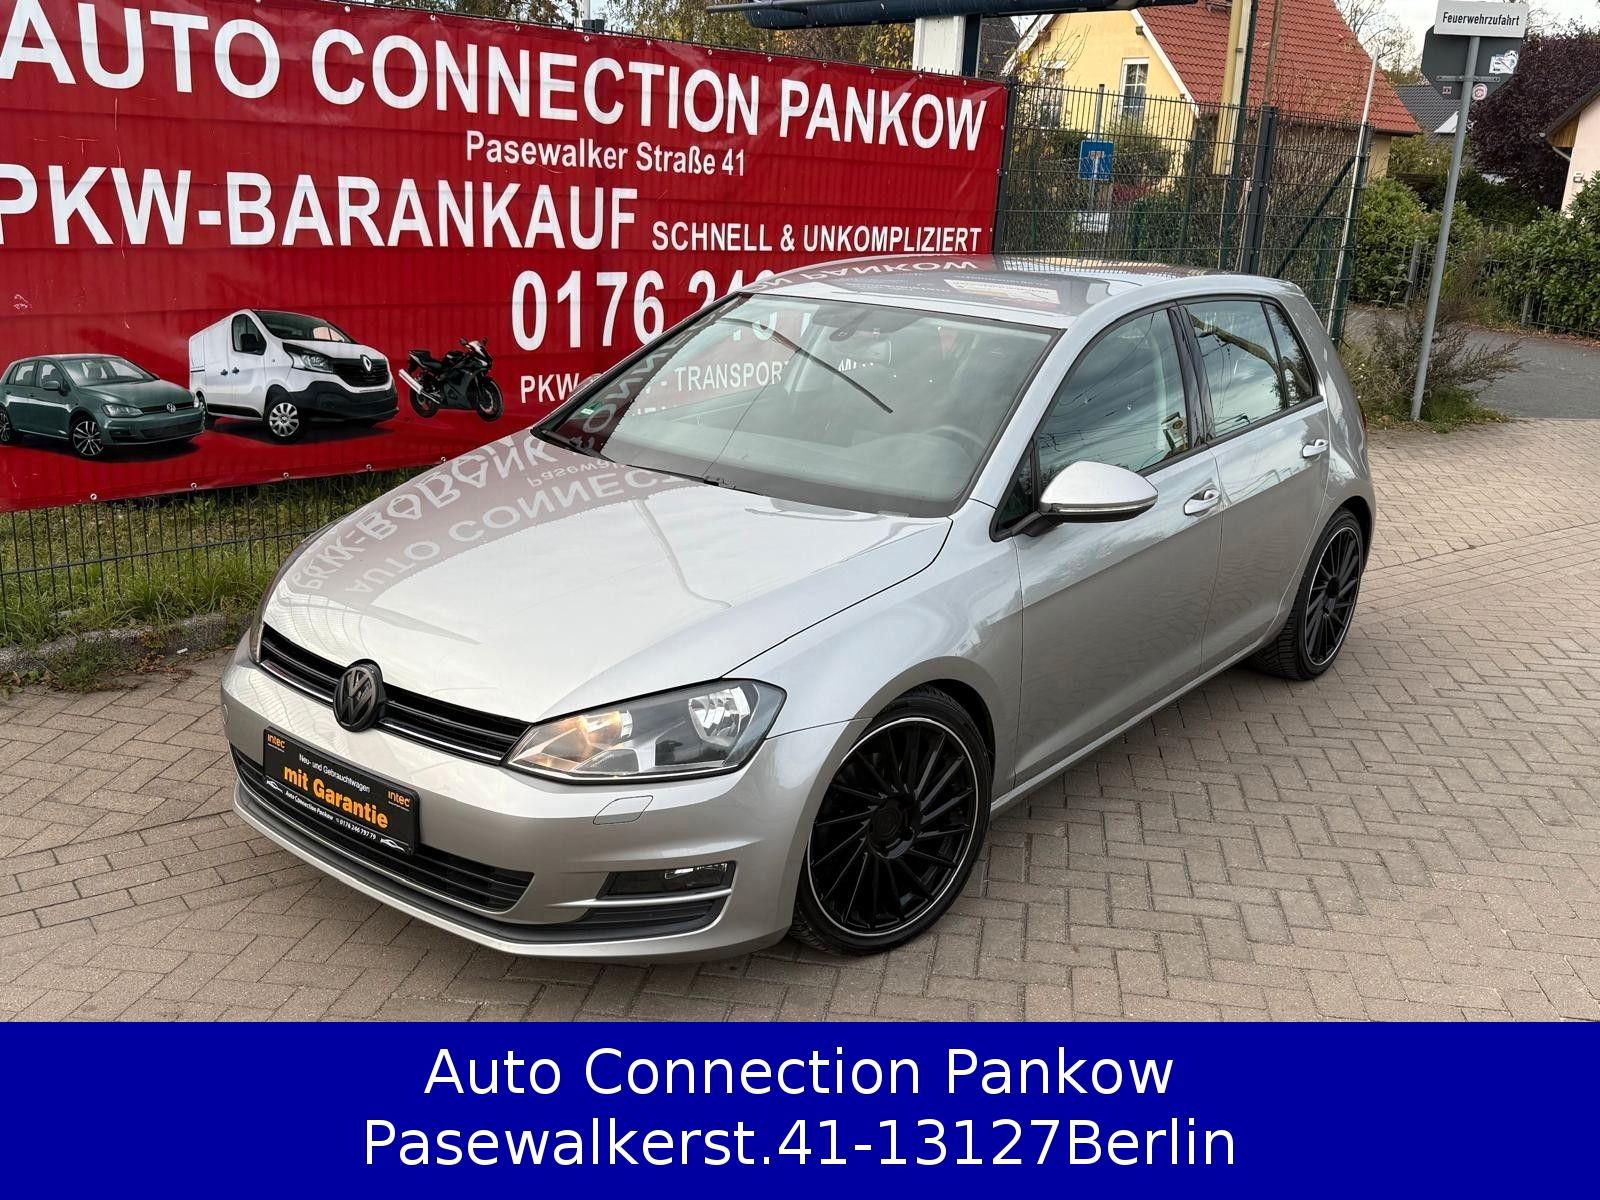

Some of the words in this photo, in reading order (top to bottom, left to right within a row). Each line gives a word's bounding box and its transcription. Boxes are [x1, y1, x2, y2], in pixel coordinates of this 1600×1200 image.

[1442, 11, 1520, 26] Feuerwehrzufahrt
[0, 0, 281, 99] AUTO
[311, 28, 759, 136] CONNECTION
[779, 78, 986, 151] PANKOW
[466, 130, 629, 170] Pasewalker
[636, 141, 716, 175] Straße
[721, 148, 745, 176] 41
[0, 163, 638, 249] PKW-BARANKAUF
[651, 220, 773, 252] SCHNELL
[780, 223, 796, 252] &
[803, 224, 982, 252] UNKOMPLIZIERT
[511, 270, 667, 351] 0176
[520, 373, 579, 404] PKW
[674, 360, 790, 392] TRANSPOR
[298, 753, 312, 765] Neu-
[311, 761, 323, 772] und
[322, 765, 371, 794] Gebrauchtwagen
[284, 766, 309, 792] mit
[313, 778, 389, 829] Garantie
[316, 807, 334, 821] Pankow
[387, 790, 411, 808] intec
